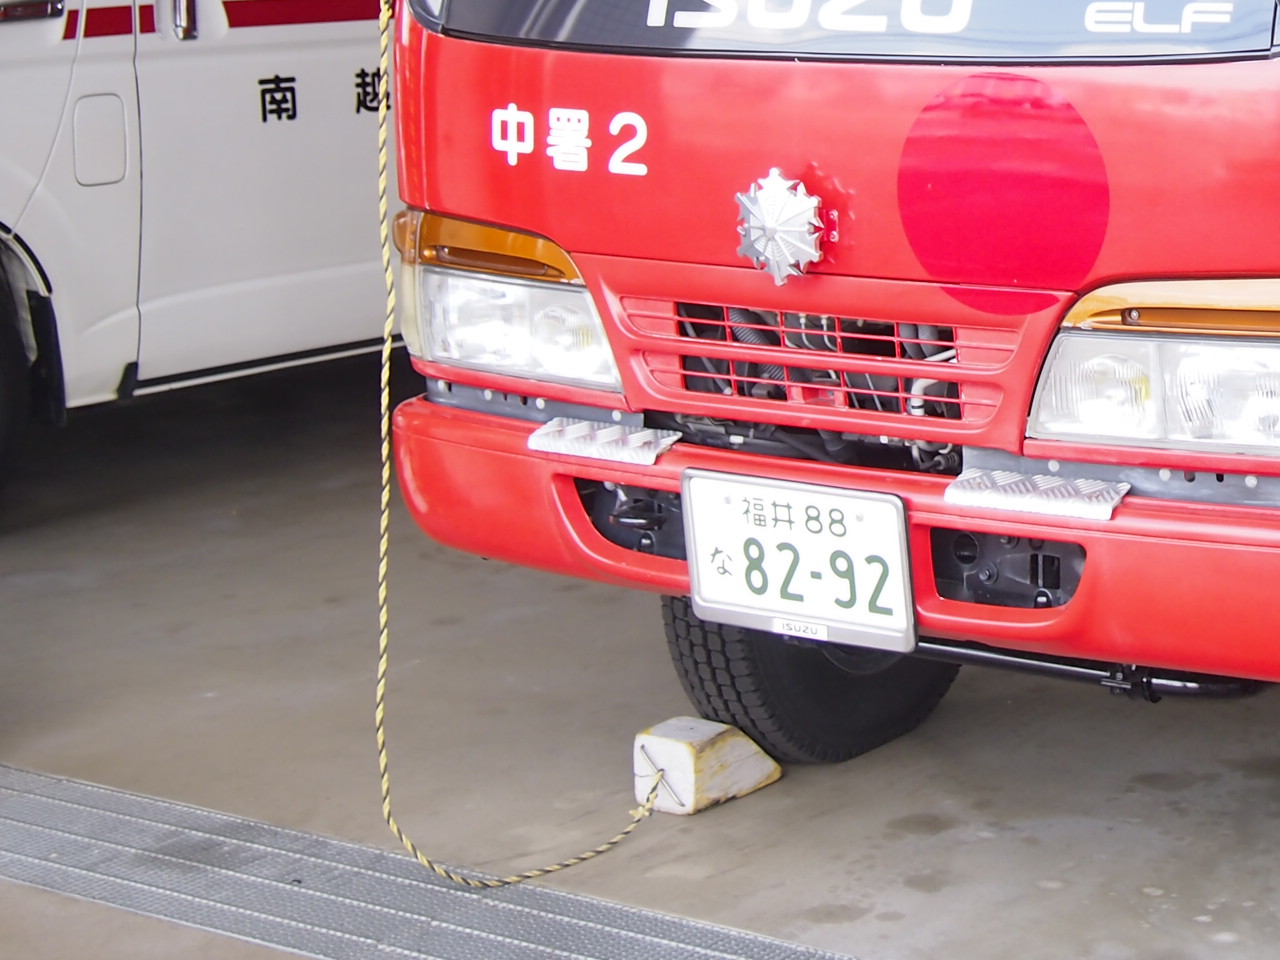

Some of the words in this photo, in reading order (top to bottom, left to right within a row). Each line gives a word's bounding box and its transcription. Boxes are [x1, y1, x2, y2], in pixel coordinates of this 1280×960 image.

[1084, 1, 1234, 33] ELF
[743, 537, 893, 616] 82-92
[782, 622, 818, 635] ISUZU
